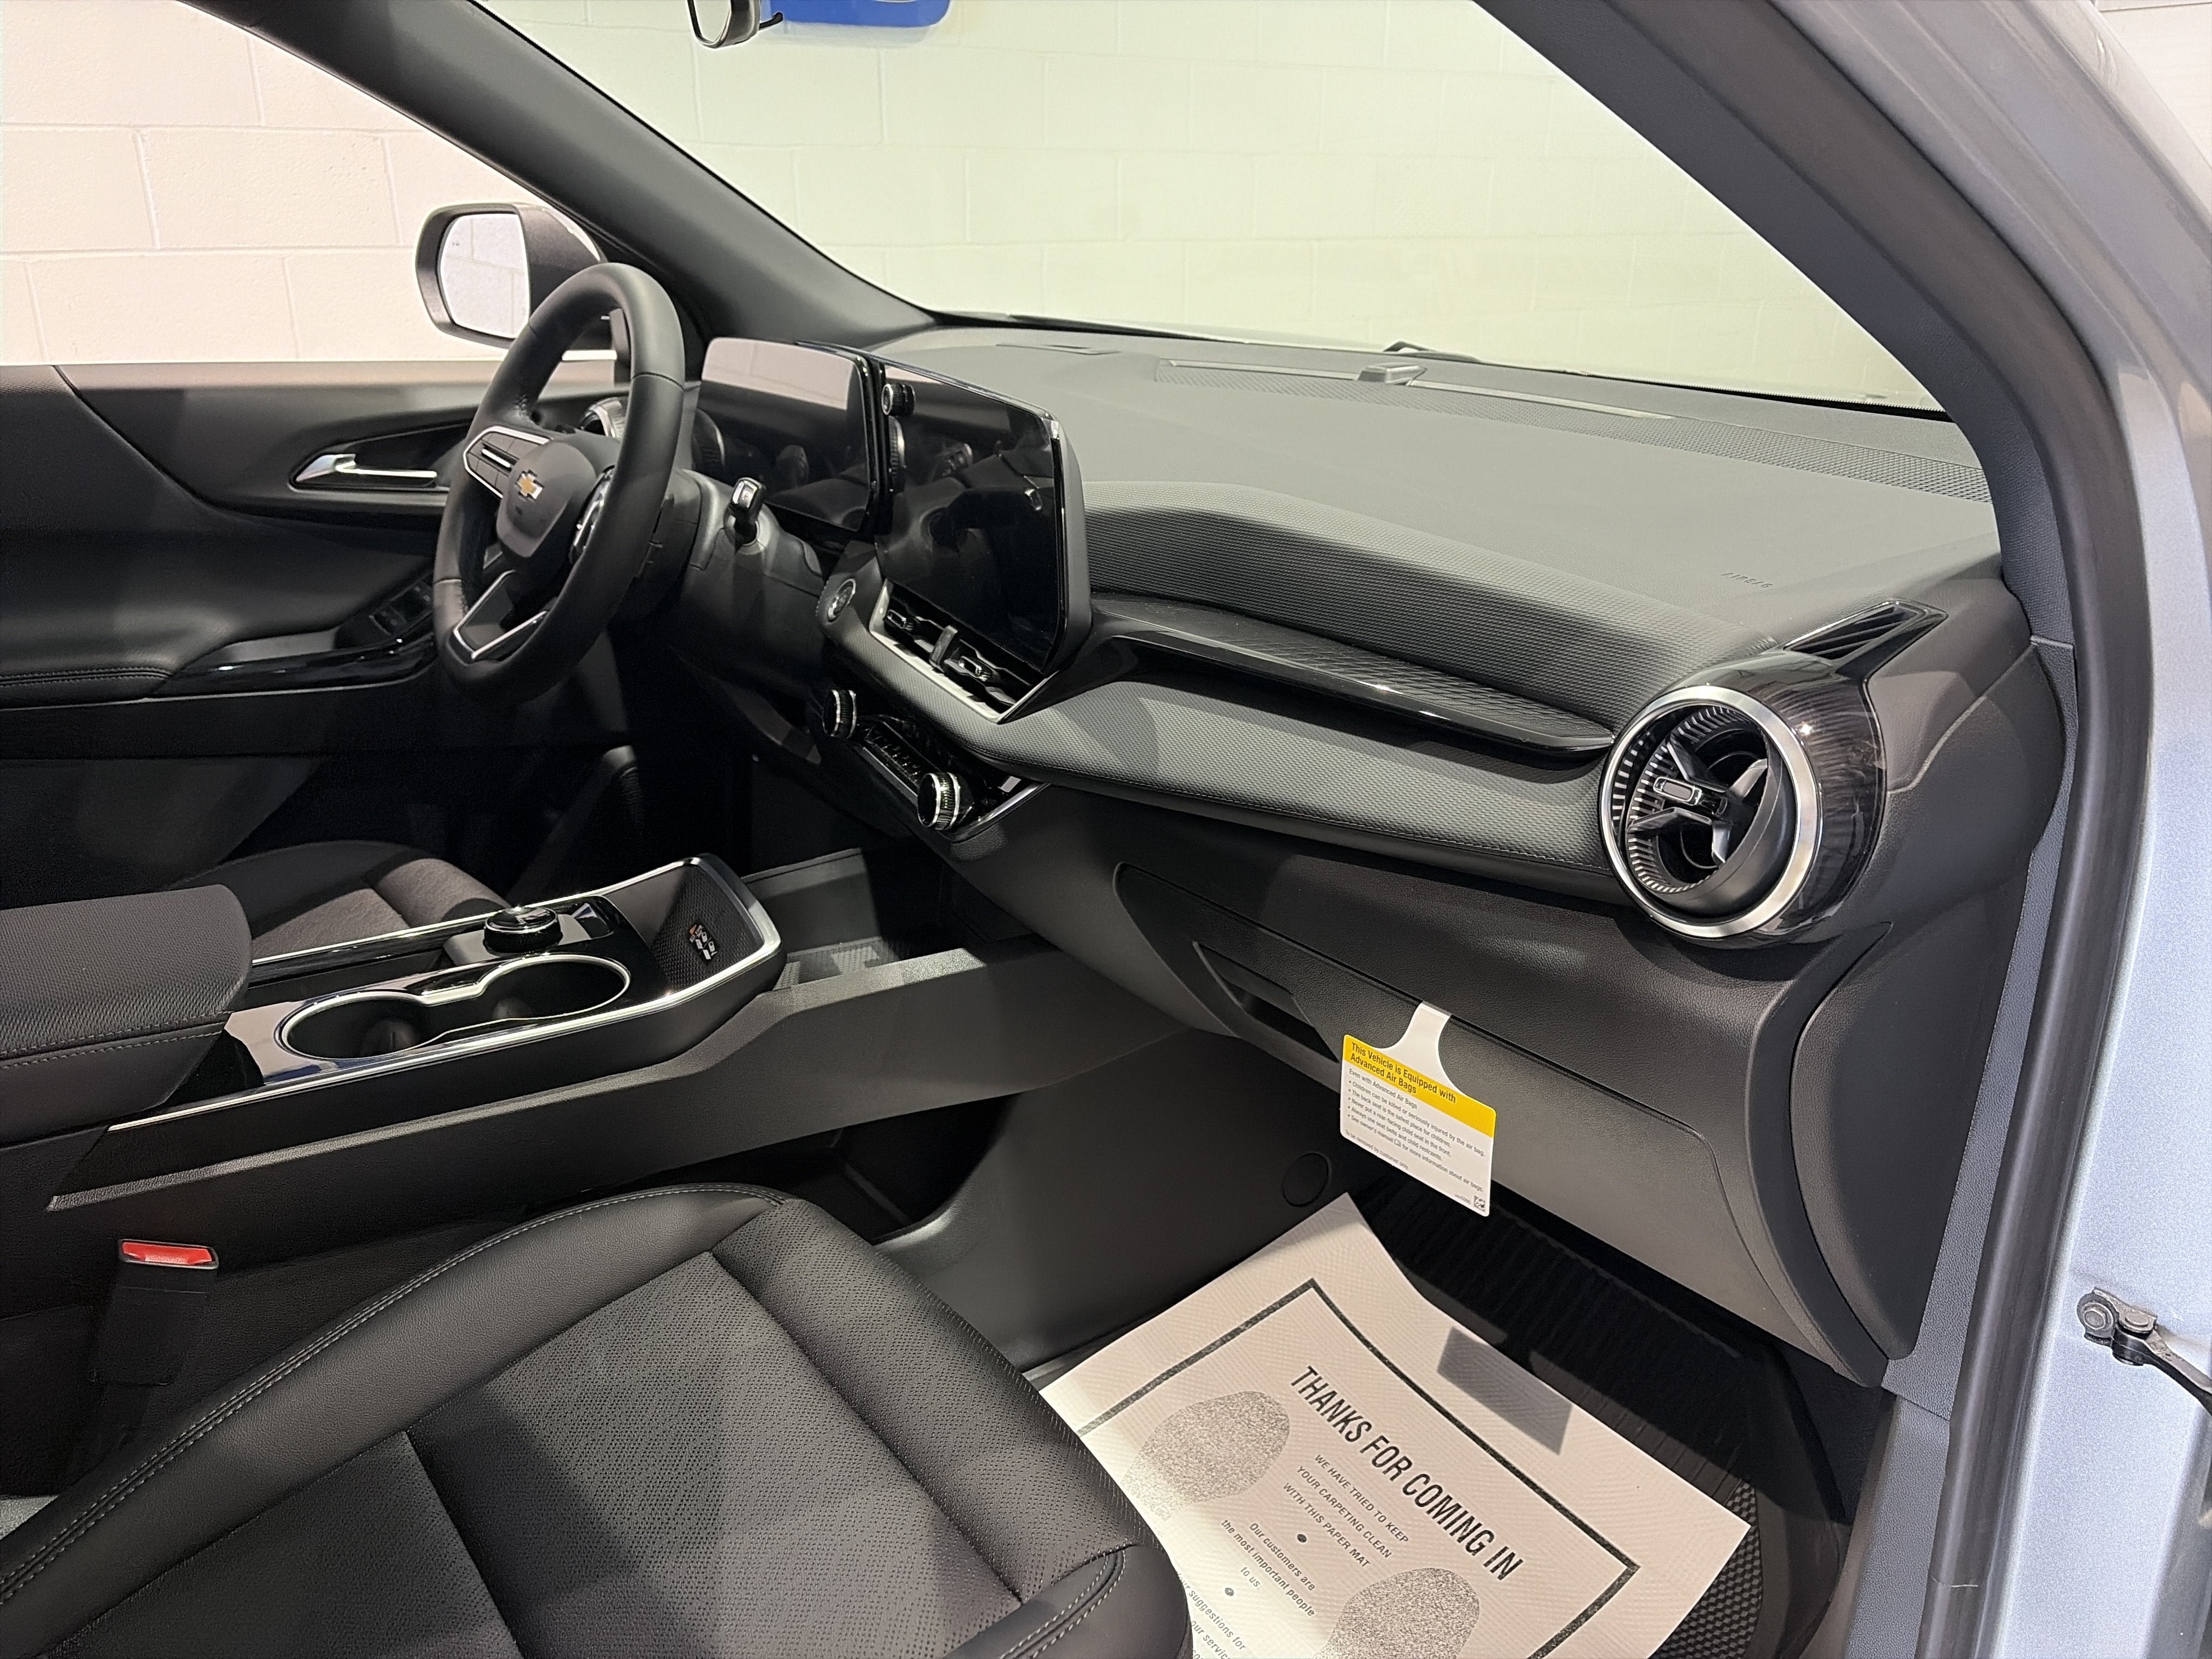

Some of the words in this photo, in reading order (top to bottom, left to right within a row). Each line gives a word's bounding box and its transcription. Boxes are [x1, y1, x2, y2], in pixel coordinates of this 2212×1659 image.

[1349, 1068, 1361, 1079] Even
[1361, 1075, 1372, 1085] with
[1372, 1081, 1396, 1098] Advanced
[1404, 1098, 1418, 1109] Bags
[1350, 1053, 1385, 1077] Advanced
[1386, 1071, 1397, 1083] Air
[1398, 1077, 1417, 1094] Bags
[1351, 1042, 1366, 1057] This
[1368, 1050, 1393, 1070] Vehicle
[1395, 1064, 1402, 1075] is
[1403, 1069, 1437, 1093] Equipped
[1439, 1088, 1456, 1103] with
[1351, 1098, 1364, 1109] Never
[1376, 1113, 1401, 1130] rear-facing
[1402, 1126, 1413, 1136] child
[1414, 1133, 1424, 1142] seat
[1430, 1141, 1438, 1150] the
[1351, 1107, 1367, 1119] Always
[1376, 1121, 1386, 1130] seat
[1386, 1125, 1397, 1136] belts
[1407, 1138, 1419, 1148] child
[1351, 1115, 1359, 1123] See
[1377, 1131, 1393, 1143] manual
[1409, 1148, 1421, 1158] more
[1422, 1154, 1448, 1173] information
[1448, 1170, 1463, 1181] about
[1352, 1081, 1372, 1096] Children
[1372, 1092, 1381, 1101] can
[1388, 1101, 1401, 1111] killed
[1408, 1112, 1430, 1127] seriously
[1431, 1123, 1448, 1137] injured
[1449, 1133, 1455, 1141] by
[1457, 1137, 1465, 1146] the
[1474, 1146, 1485, 1156] bag.
[1352, 1090, 1360, 1098] The
[1361, 1094, 1372, 1104] back
[1372, 1102, 1381, 1110] seat
[1395, 1114, 1409, 1125] safest
[1409, 1122, 1423, 1132] place
[1431, 1133, 1452, 1148] children.
[1290, 1365, 1373, 1443] THANKS
[1359, 1435, 1413, 1482] FOR
[1402, 1474, 1495, 1557] COMING
[1483, 1545, 1524, 1581] IN
[1314, 1454, 1330, 1469] WE
[1327, 1468, 1352, 1489] HAVE
[1349, 1487, 1374, 1511] TRIED
[1373, 1510, 1387, 1523] TO
[1385, 1521, 1409, 1543] KEEP
[1283, 1482, 1306, 1505] WITH
[1304, 1503, 1325, 1523] THIS
[1322, 1522, 1351, 1550] PAPER
[1349, 1548, 1371, 1567] MAT
[1296, 1466, 1321, 1489] YOUR
[1318, 1488, 1365, 1532] CARPETING
[1363, 1531, 1392, 1559] CLEAN
[1221, 1519, 1235, 1534] the
[1233, 1533, 1255, 1554] most
[1251, 1551, 1290, 1590] important
[1285, 1589, 1315, 1617] people
[1240, 1566, 1250, 1577] to
[1249, 1576, 1261, 1590] us.
[1249, 1522, 1265, 1538] Our
[1262, 1537, 1302, 1577] customers
[1300, 1576, 1316, 1591] are
[1188, 1590, 1234, 1639] suggestions
[1232, 1637, 1246, 1651] for
[1189, 1620, 1205, 1635] our
[1203, 1634, 1232, 1659] servic
